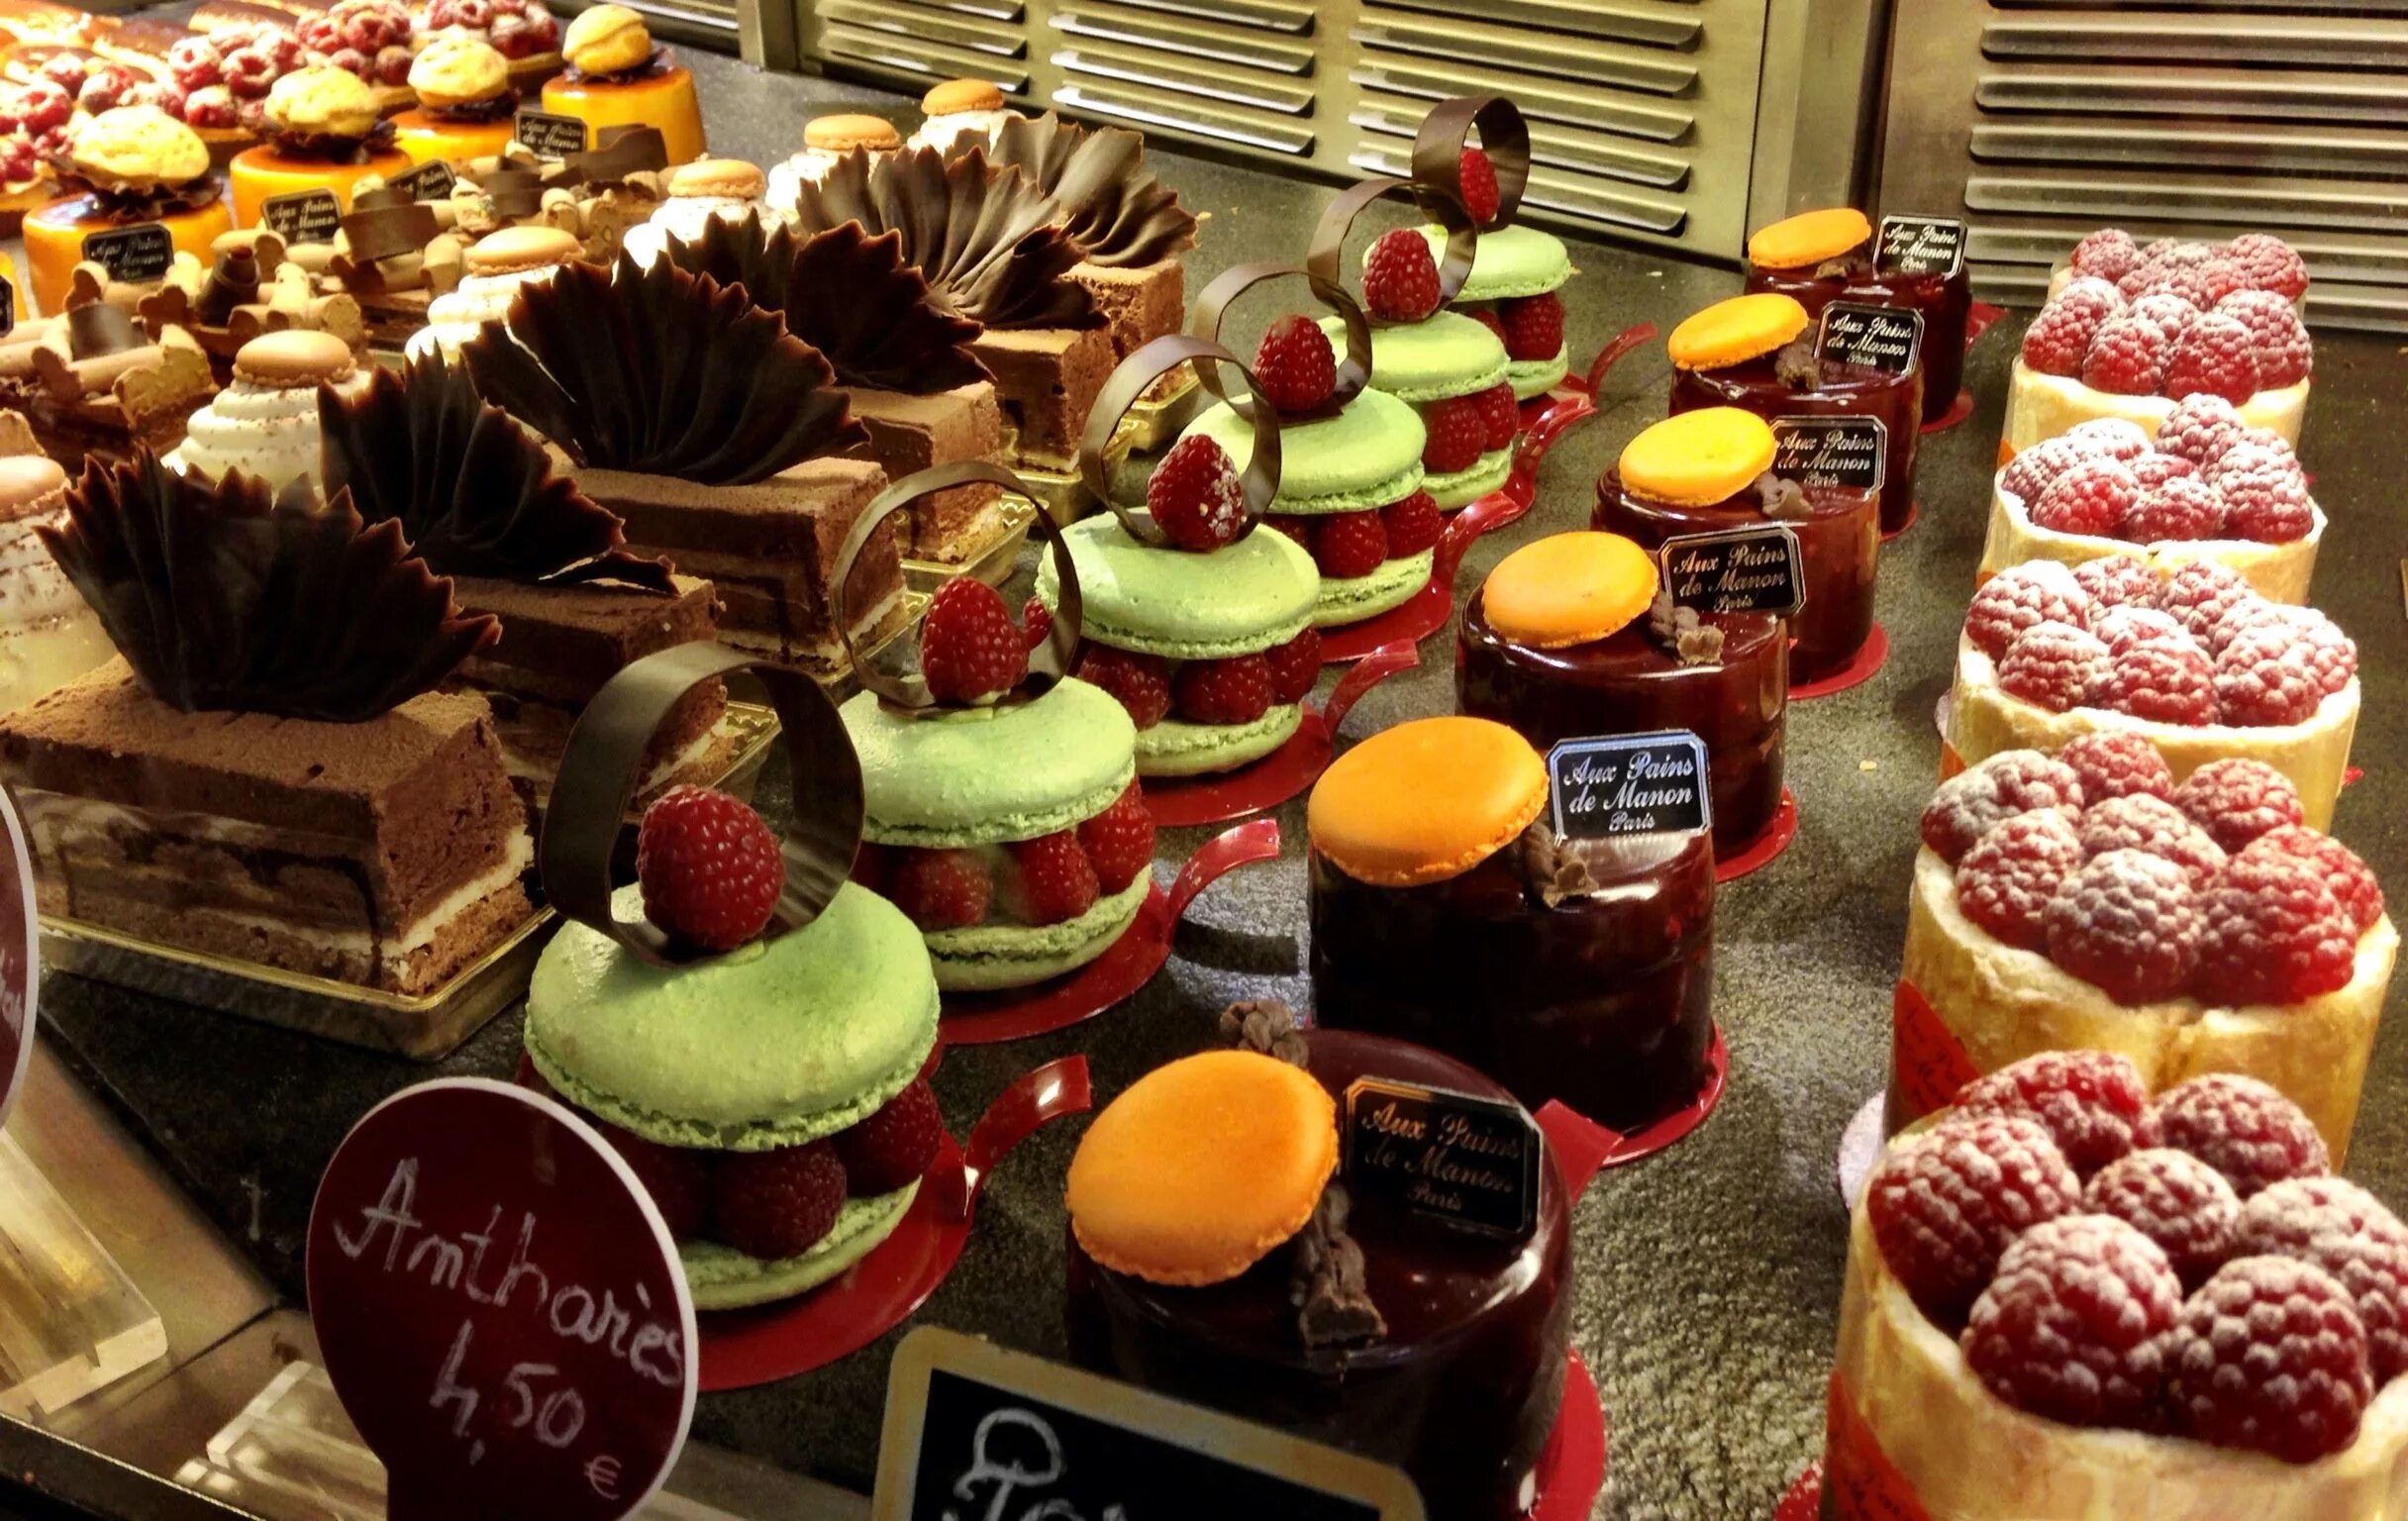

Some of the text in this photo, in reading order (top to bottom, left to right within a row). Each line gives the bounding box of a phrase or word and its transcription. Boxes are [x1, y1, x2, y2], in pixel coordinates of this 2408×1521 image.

[1884, 224, 1957, 245] Aux Pains
[1883, 240, 1953, 260] de Manon
[1829, 313, 1912, 339] Aux Pains
[1827, 332, 1906, 356] de Manon
[1775, 428, 1875, 452] Aux Pains
[1777, 449, 1871, 470] de Manon
[1673, 544, 1787, 574] Aux Pains
[1678, 568, 1787, 598] de Manon
[1713, 594, 1755, 614] Paris
[1563, 750, 1694, 786] Aux Pains
[1568, 779, 1694, 814] de Manon
[1608, 811, 1656, 833] Paris
[1361, 1100, 1521, 1160] Aux Pains
[1364, 1136, 1514, 1194] de Manon
[1407, 1180, 1462, 1212] Paris
[583, 1454, 624, 1500] €
